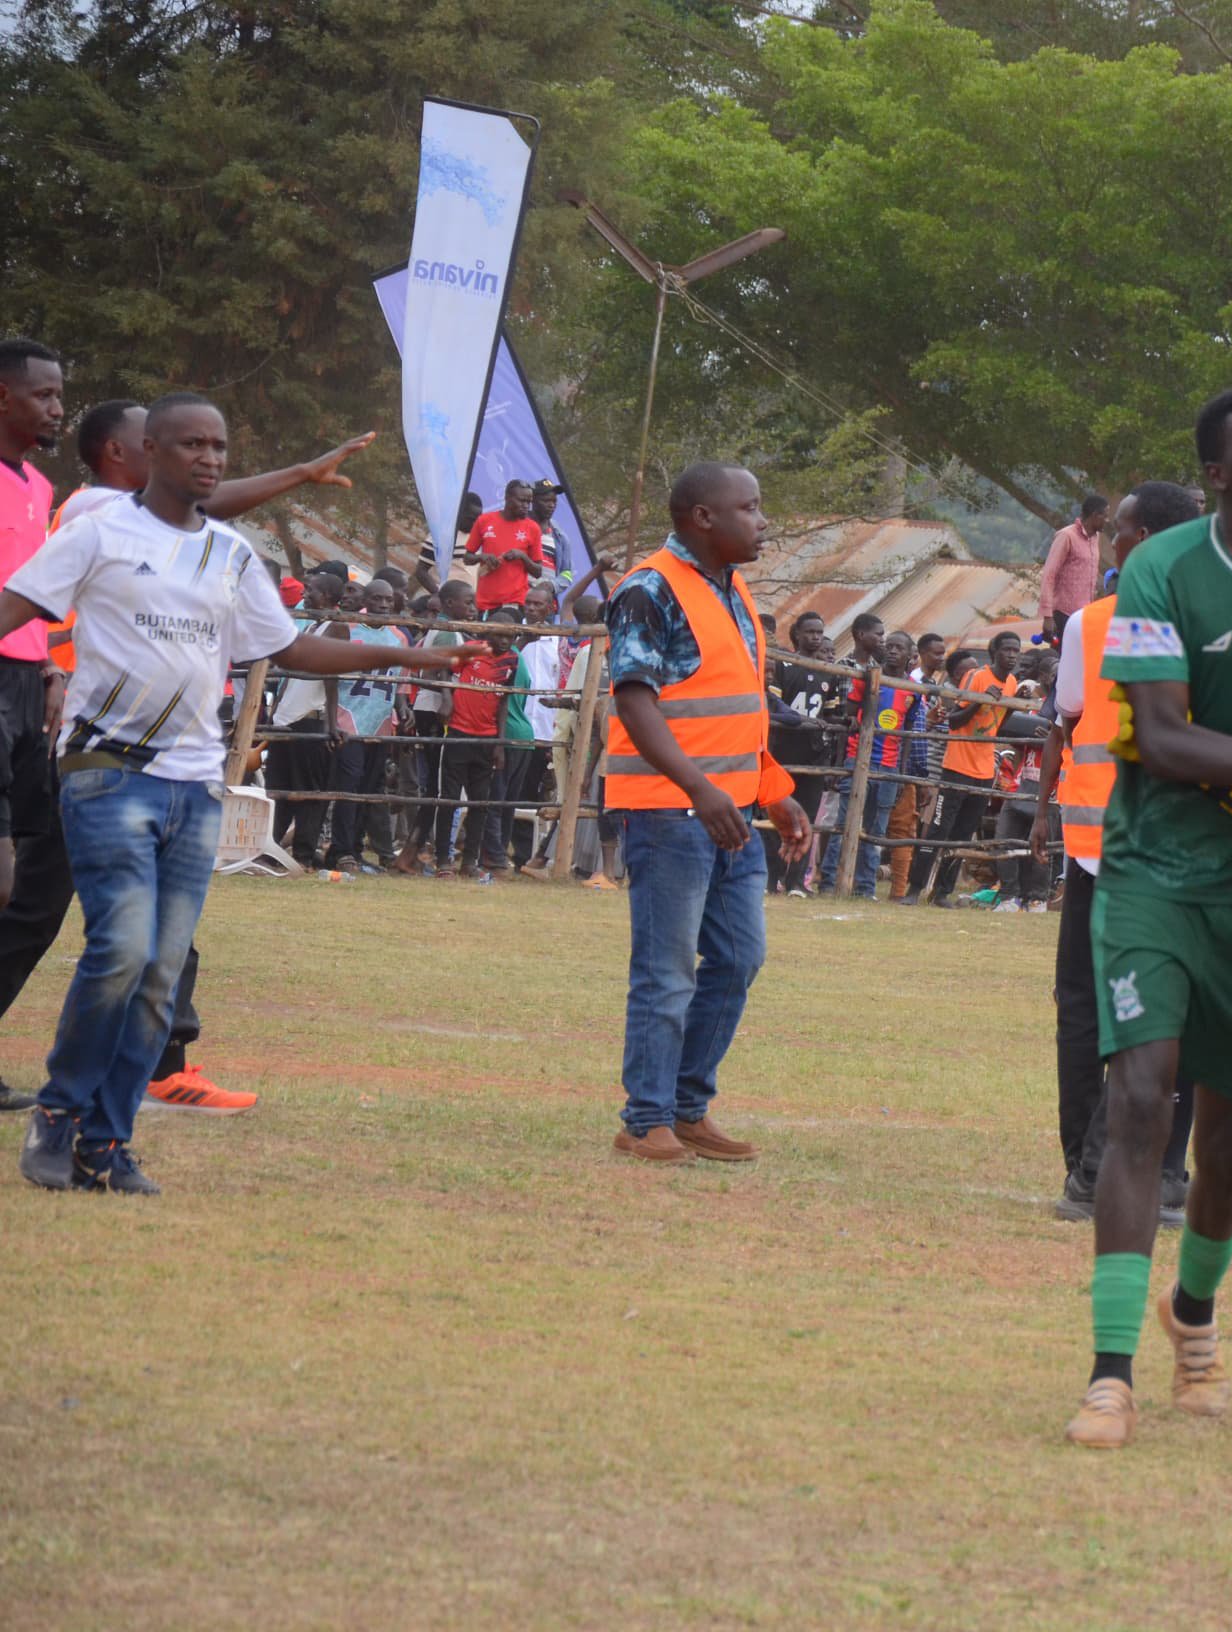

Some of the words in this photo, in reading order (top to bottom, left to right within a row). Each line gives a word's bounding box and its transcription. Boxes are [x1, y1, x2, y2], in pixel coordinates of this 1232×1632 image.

[135, 613, 220, 637] BUTAMBAL
[147, 629, 197, 644] UNITED
[790, 691, 823, 719] 42
